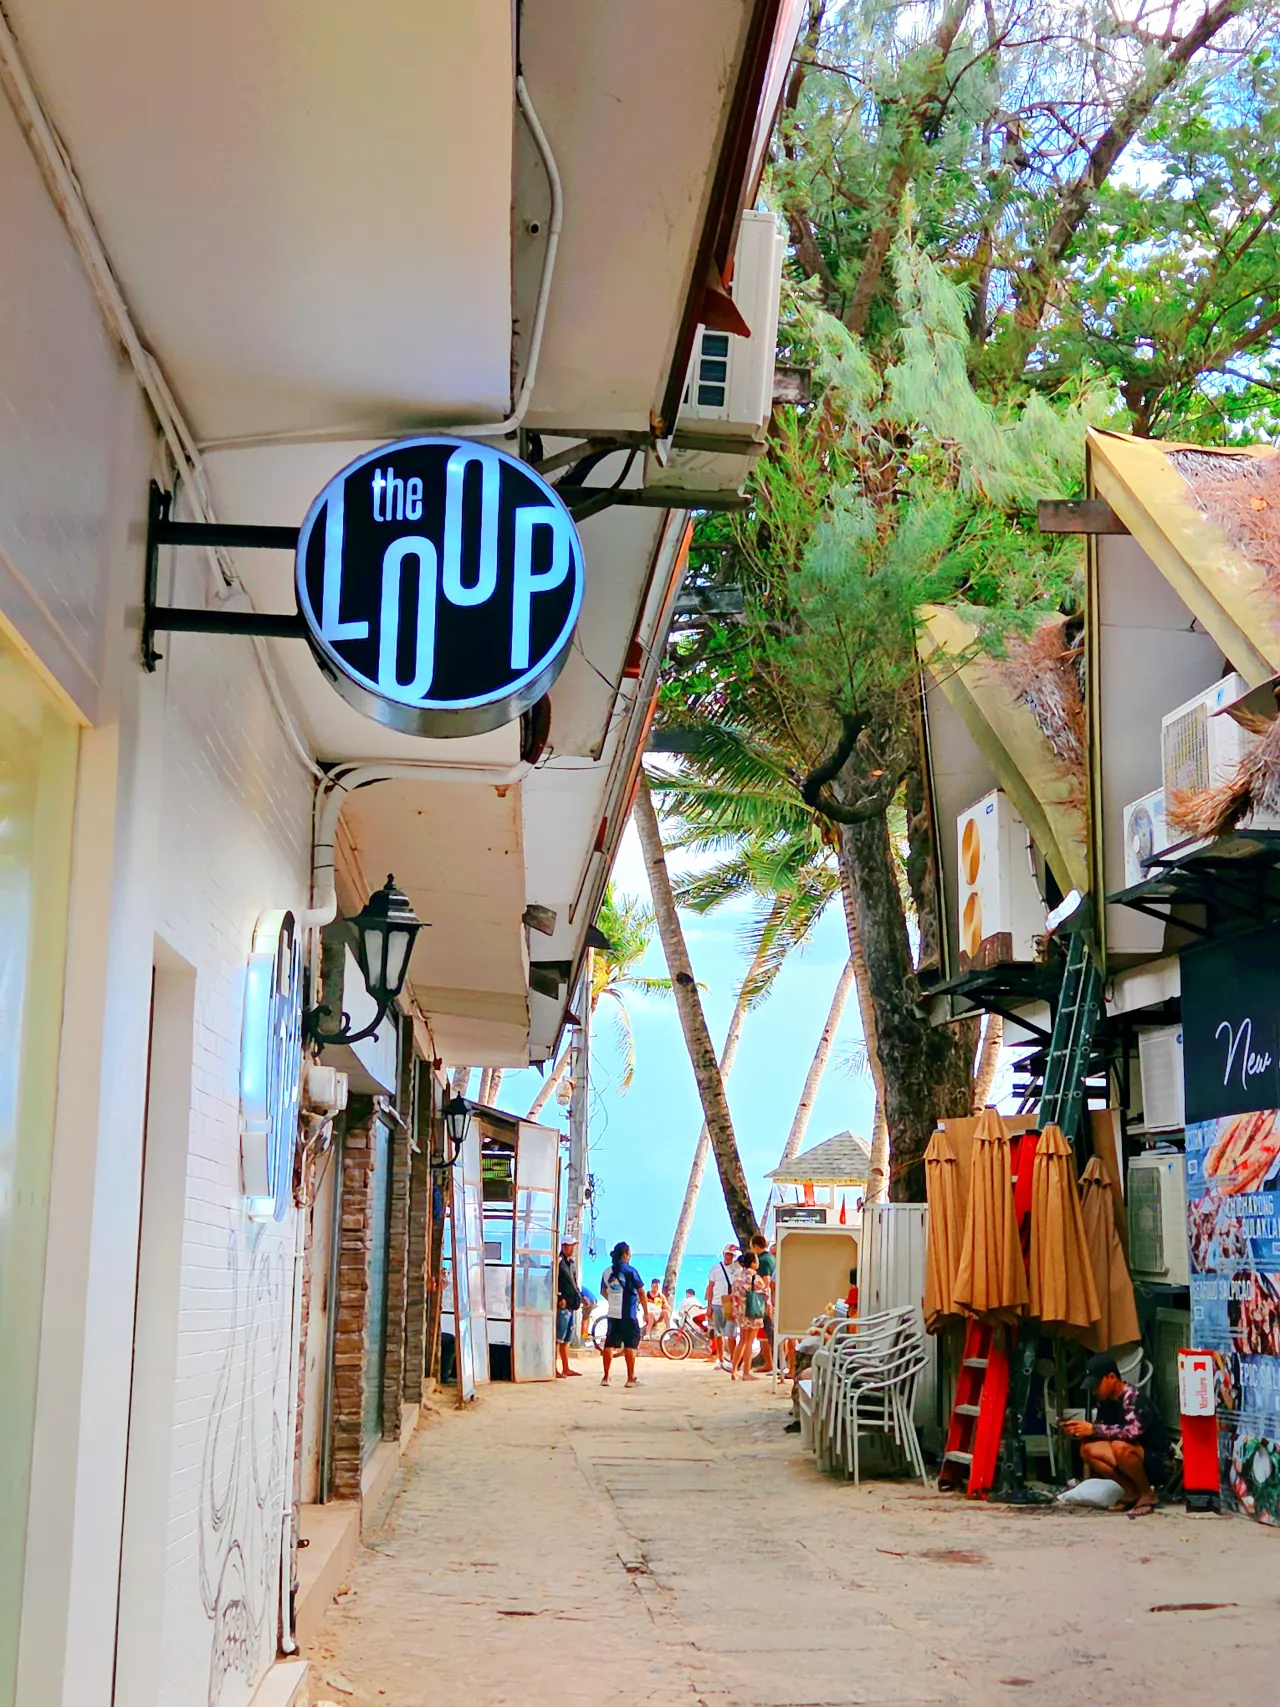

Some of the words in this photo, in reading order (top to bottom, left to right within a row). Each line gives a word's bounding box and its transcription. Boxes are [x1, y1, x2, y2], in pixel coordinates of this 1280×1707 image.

[372, 467, 423, 522] the
[321, 444, 571, 700] LOOP
[1215, 1017, 1272, 1091] New
[1242, 1217, 1280, 1239] BULAKLA
